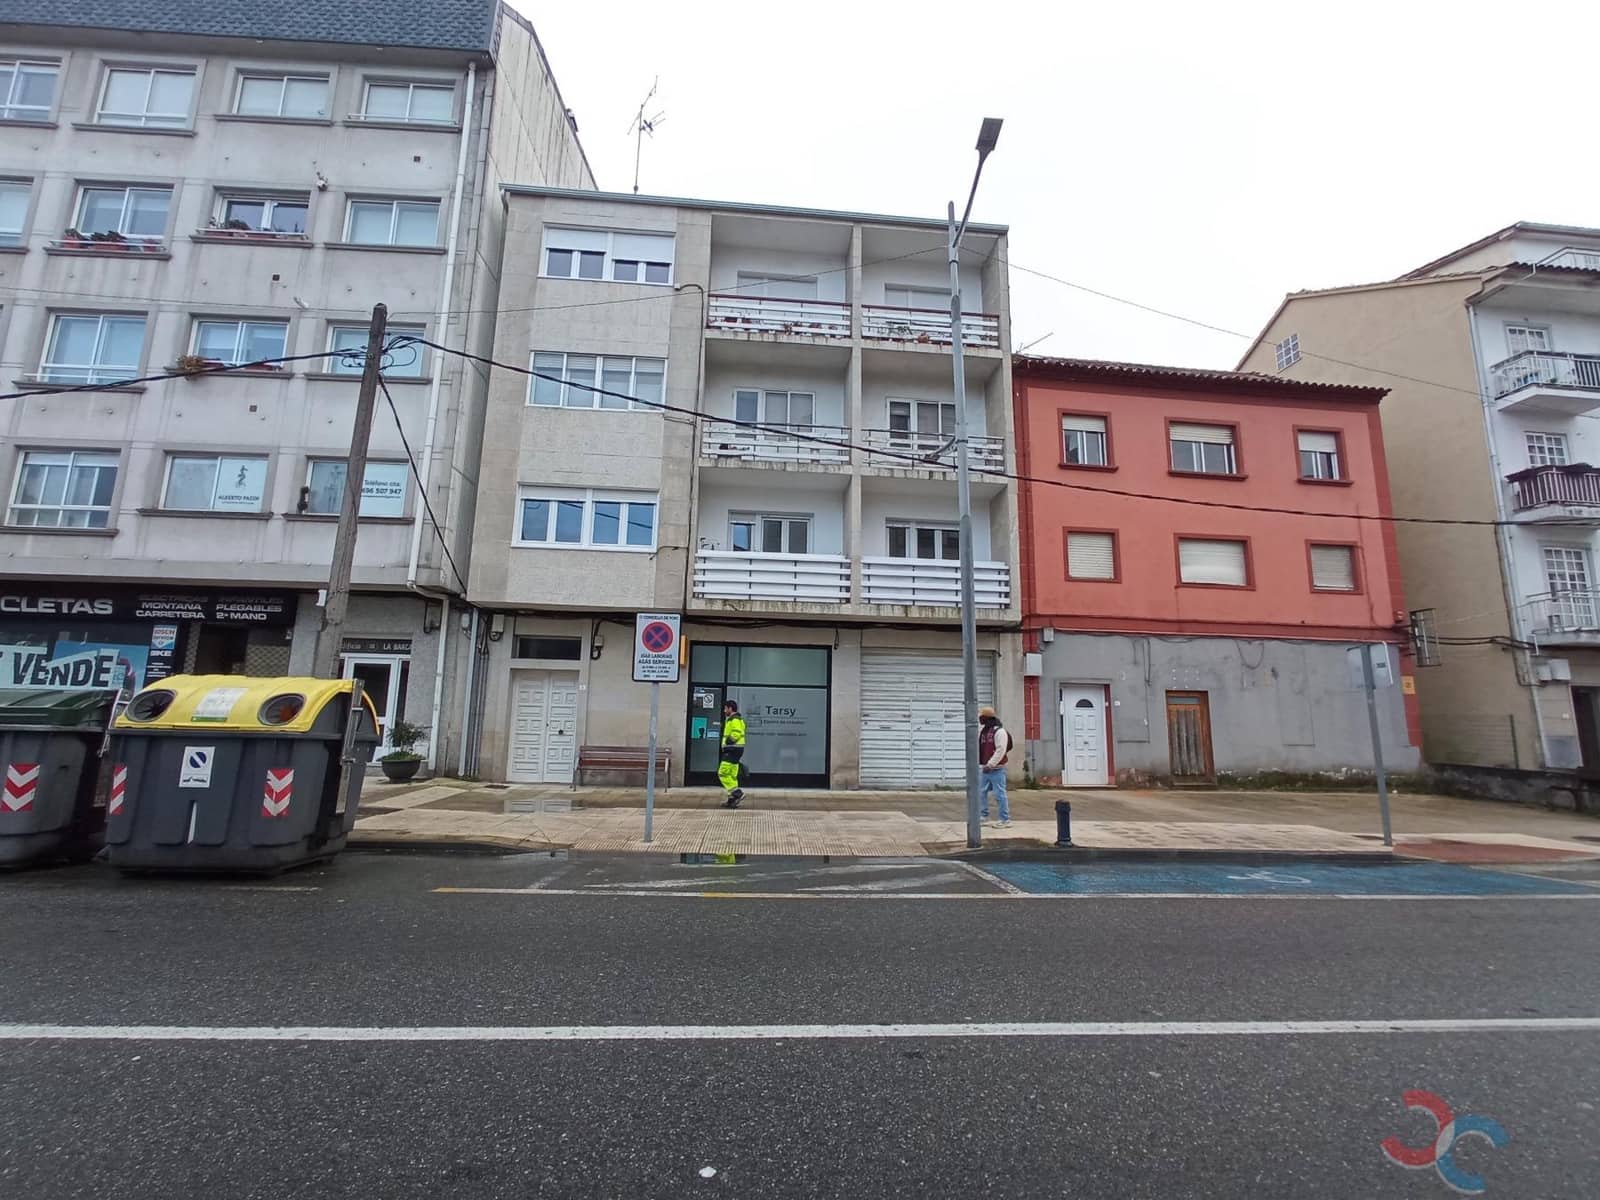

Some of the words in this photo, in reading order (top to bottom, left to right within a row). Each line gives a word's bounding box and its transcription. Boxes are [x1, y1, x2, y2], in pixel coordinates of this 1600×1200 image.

[0, 595, 113, 615] CLETAS
[215, 604, 282, 612] PLEGABLES
[135, 610, 206, 619] CARRETERA
[230, 613, 267, 621] MANO
[13, 652, 114, 688] VENDE
[765, 705, 796, 717] Tarsy
